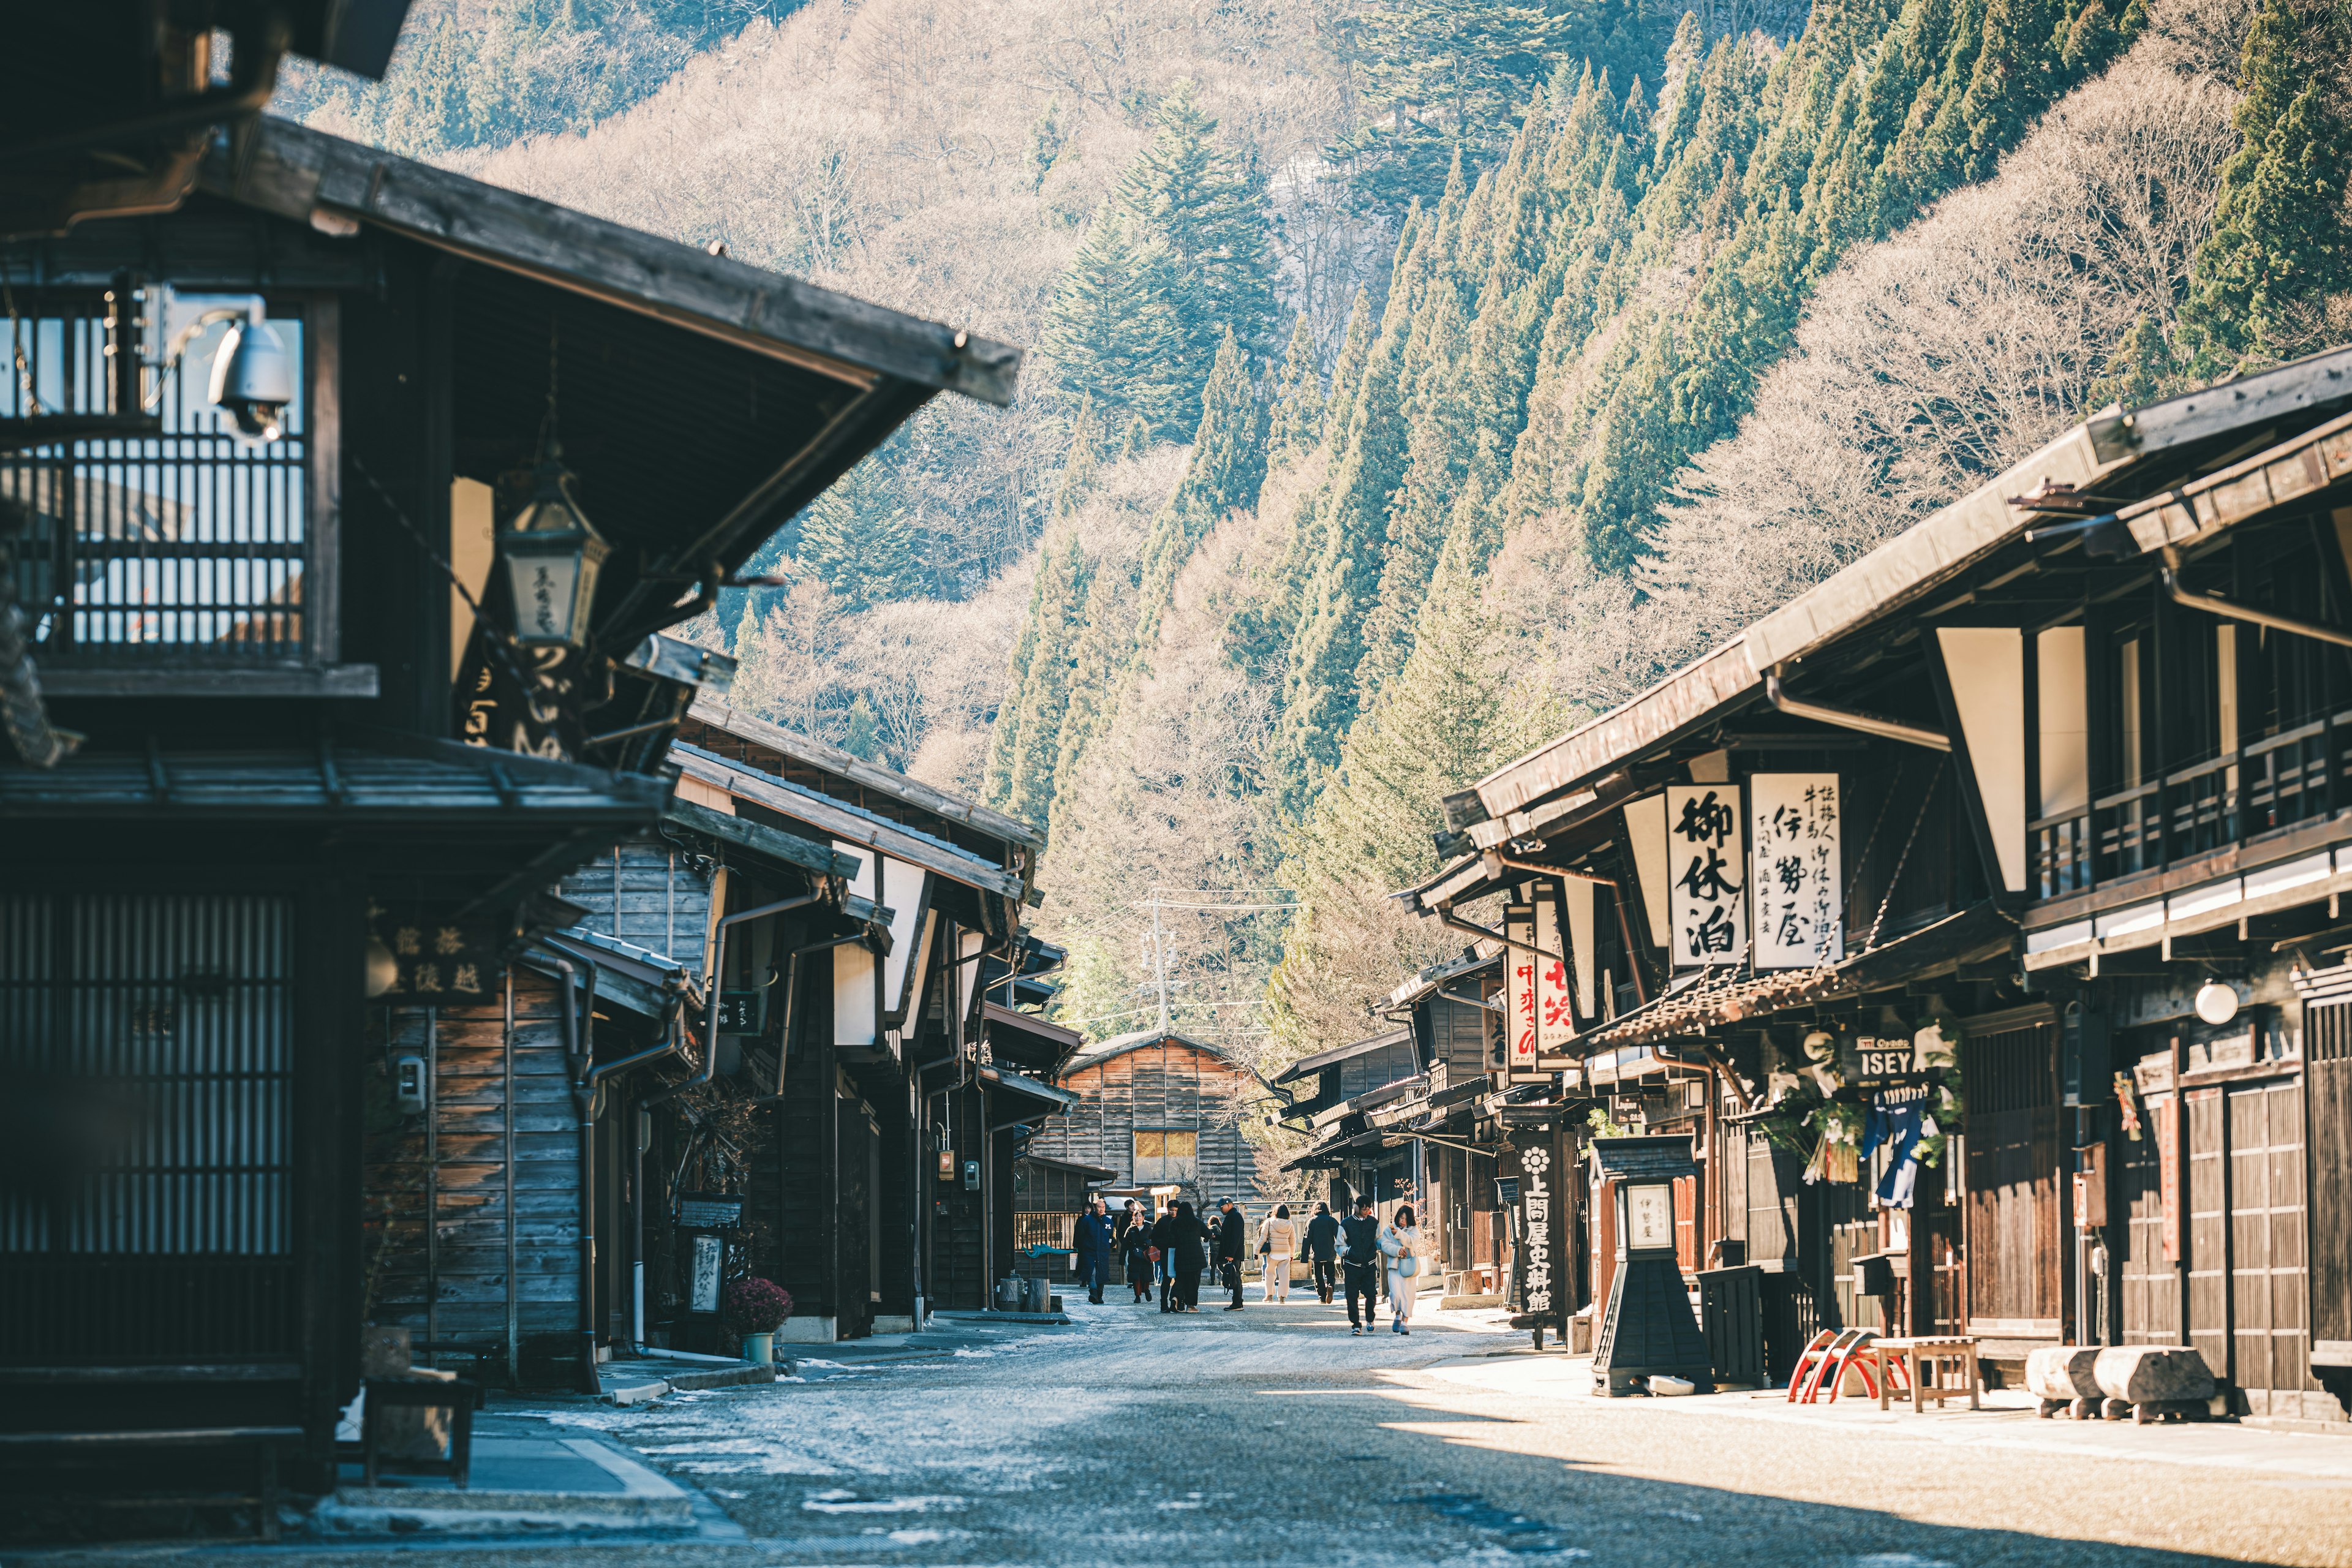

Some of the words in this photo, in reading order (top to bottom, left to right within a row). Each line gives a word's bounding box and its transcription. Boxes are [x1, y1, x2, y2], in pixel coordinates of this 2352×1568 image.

[1673, 791, 1741, 957] 御休泊
[1773, 804, 1809, 947] 伊勢屋
[1545, 961, 1570, 1027] 七笑
[1525, 1175, 1551, 1313] 上問屋史料館
[1640, 1199, 1653, 1237] 伊勢屋
